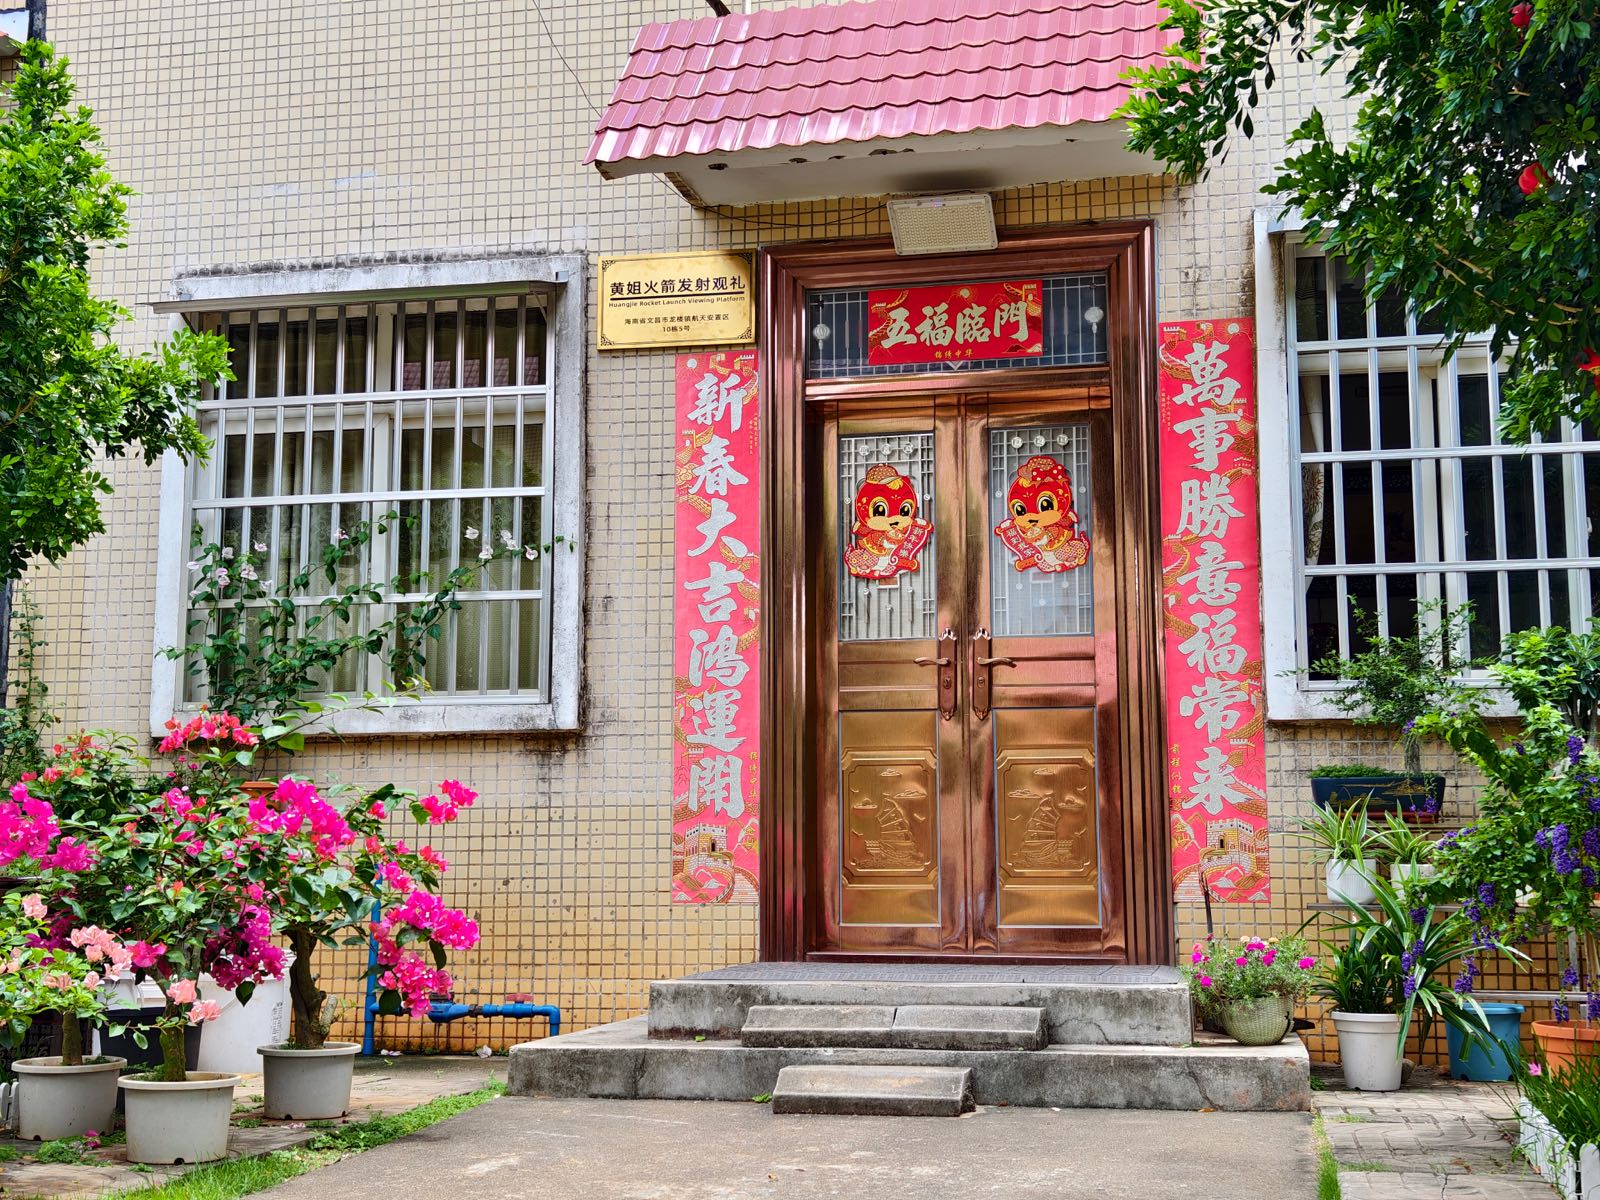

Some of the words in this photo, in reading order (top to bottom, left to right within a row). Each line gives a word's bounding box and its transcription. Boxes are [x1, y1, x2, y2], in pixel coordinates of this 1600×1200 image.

[609, 275, 746, 296] 黄姐火箭发射观礼
[608, 301, 638, 309] Huangjie
[688, 296, 715, 304] Viewing
[716, 295, 746, 303] Platform
[624, 313, 730, 325] 海南省文昌市龙楼镇航天安置区
[881, 301, 1029, 348] 五福臨門
